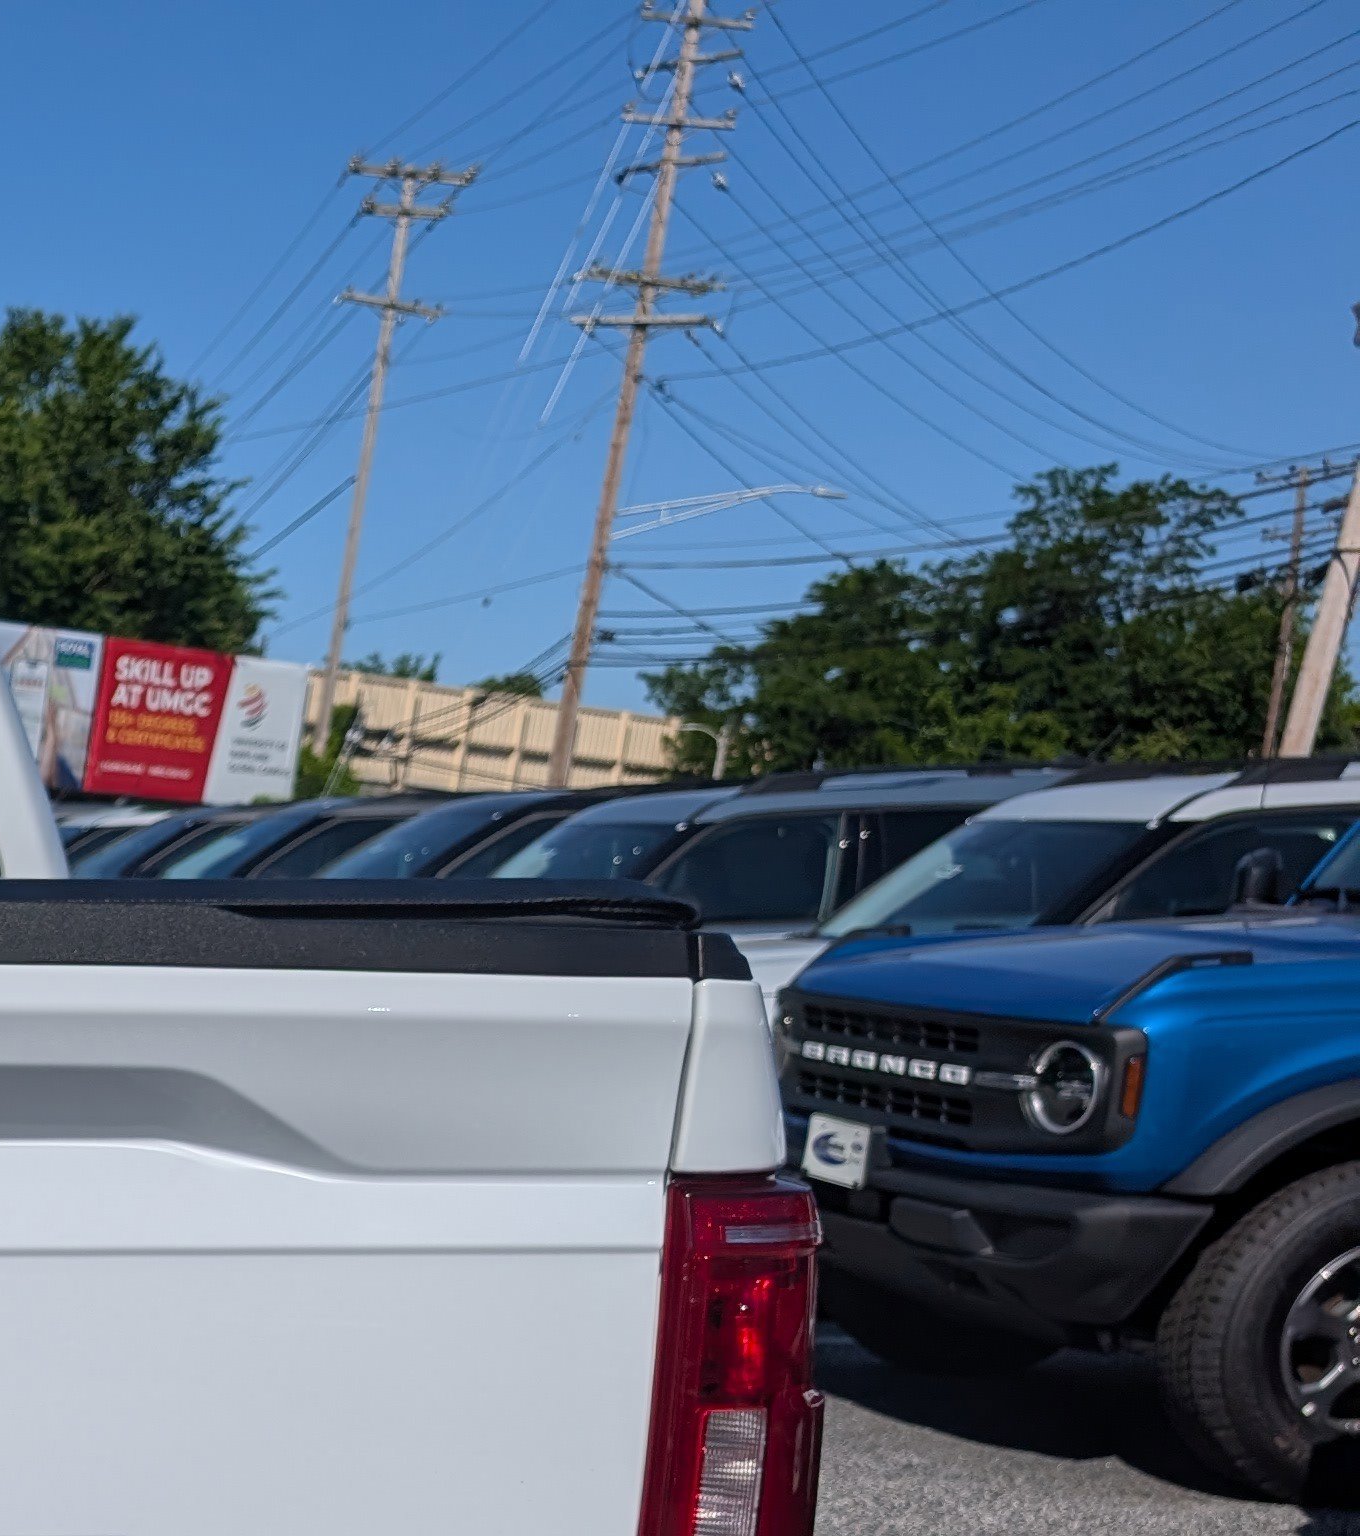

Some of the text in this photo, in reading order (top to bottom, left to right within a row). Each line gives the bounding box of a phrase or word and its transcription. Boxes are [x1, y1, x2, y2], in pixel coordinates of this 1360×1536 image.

[115, 655, 214, 690] SKILL UP
[111, 682, 212, 718] AT UMGC
[802, 1040, 972, 1086] BRONCO
